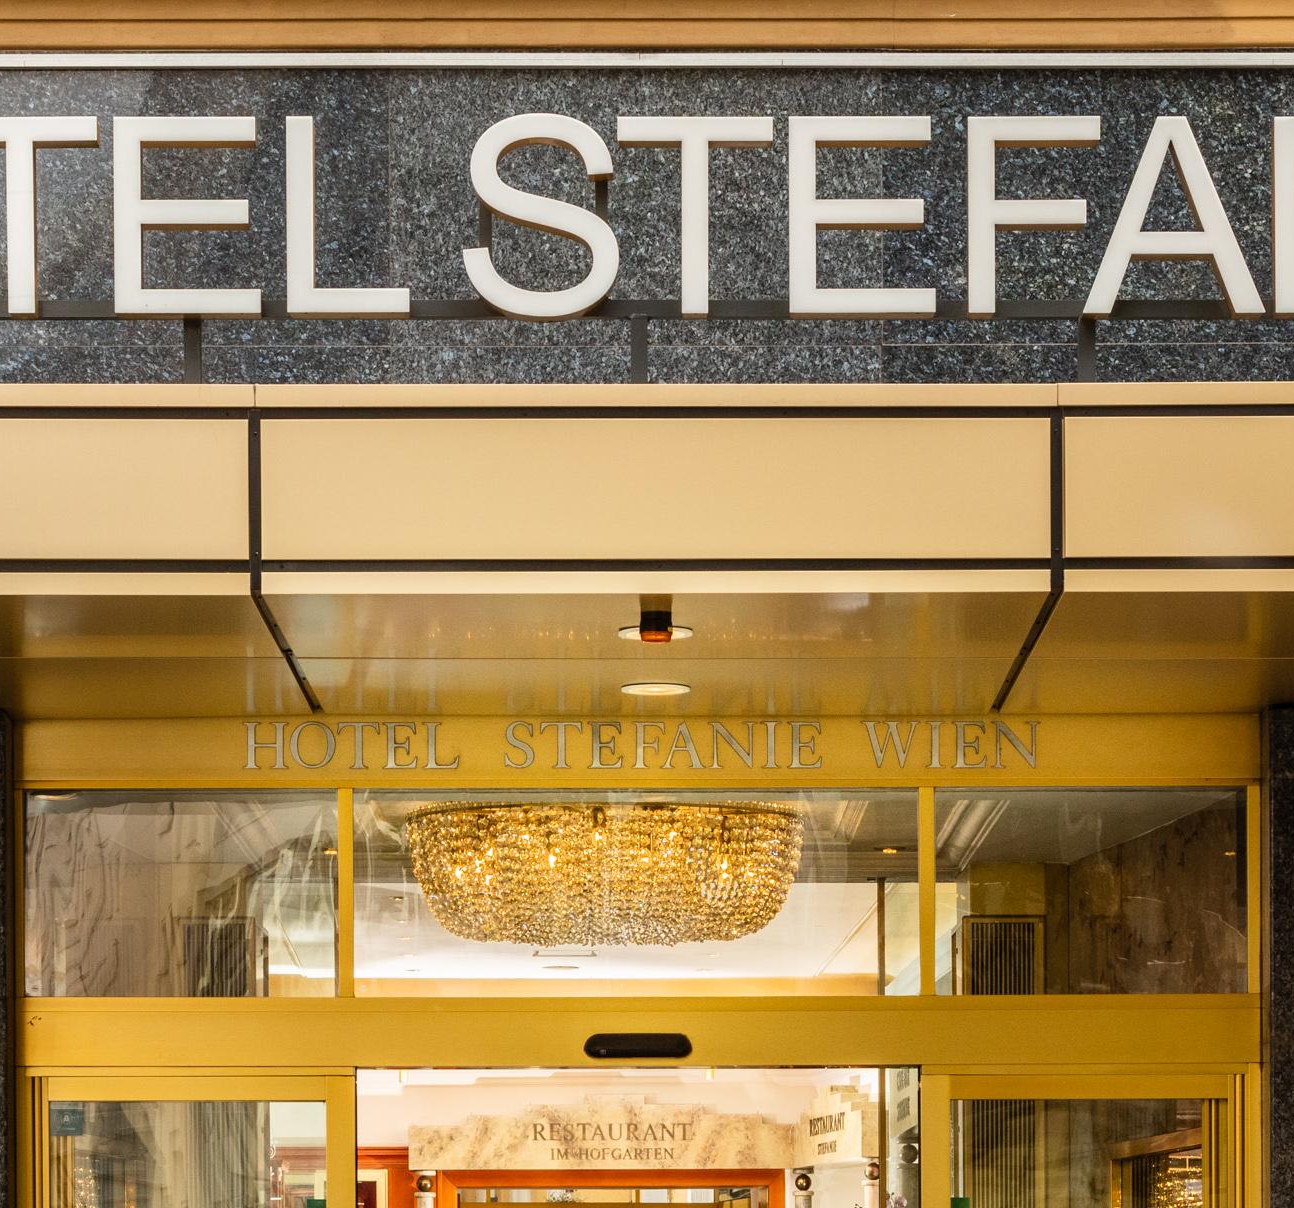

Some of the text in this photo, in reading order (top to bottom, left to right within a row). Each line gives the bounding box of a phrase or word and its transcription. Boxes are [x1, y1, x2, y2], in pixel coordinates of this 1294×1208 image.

[242, 720, 1041, 769] HOTEL STEFANIE WIEN
[532, 1121, 694, 1142] RESTAURANT
[809, 1111, 846, 1137] RESTAURANT
[550, 1147, 675, 1161] IM HOFGARTEN
